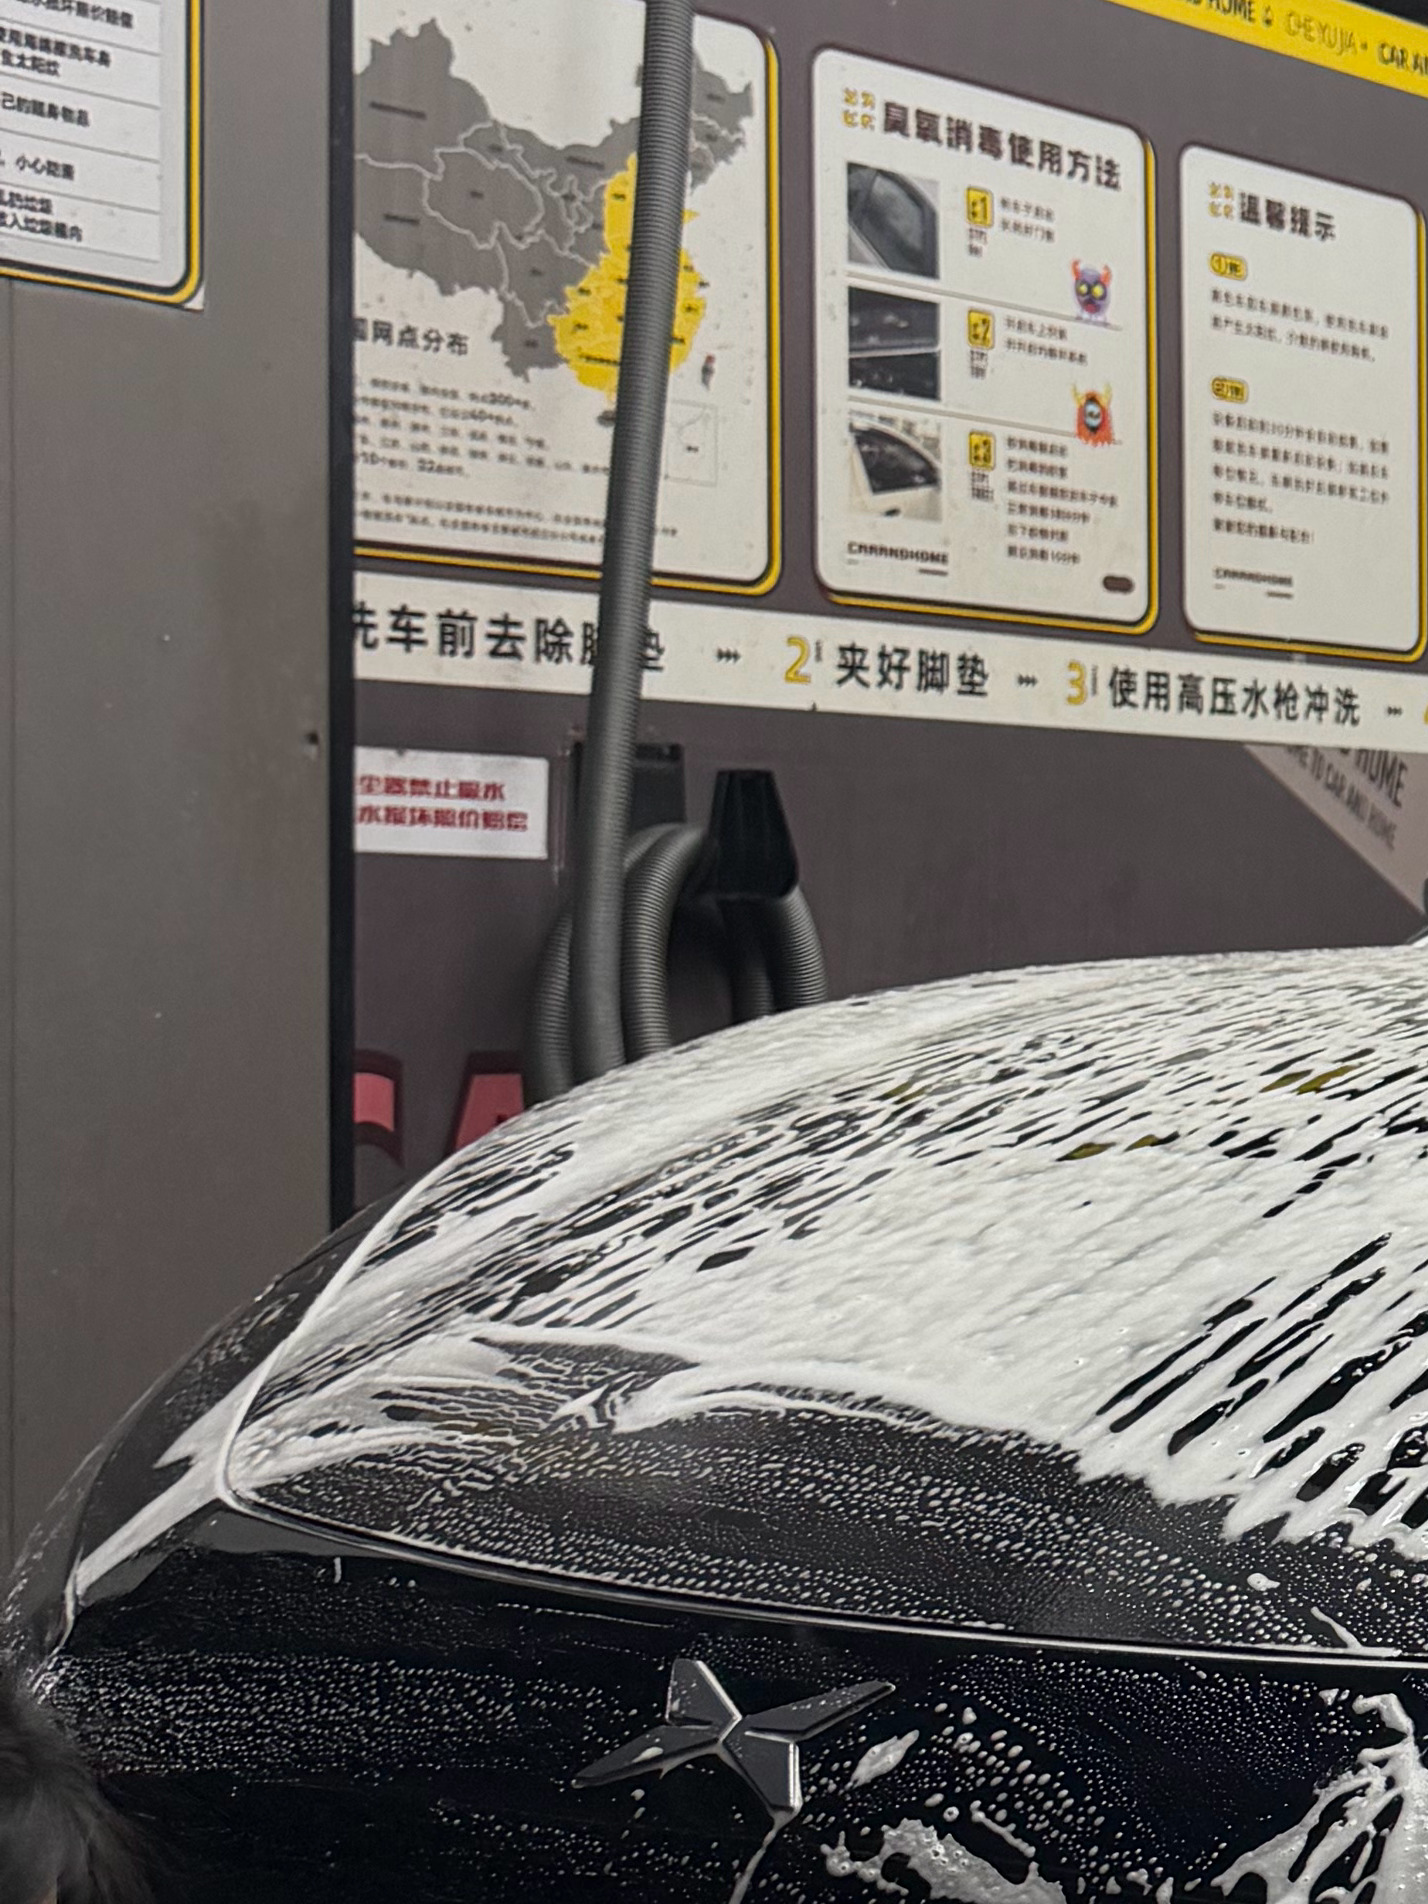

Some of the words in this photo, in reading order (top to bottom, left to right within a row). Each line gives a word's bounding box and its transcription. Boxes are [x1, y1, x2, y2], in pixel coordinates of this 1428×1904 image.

[1377, 42, 1408, 71] CAR
[884, 101, 1121, 190] 臭氧消毒使用方法
[1239, 192, 1336, 241] 温馨提示
[783, 635, 812, 685] 2
[836, 642, 989, 697] 夹好脚垫
[1064, 659, 1087, 707] 3
[1108, 666, 1361, 727] 使用高压水枪冲洗
